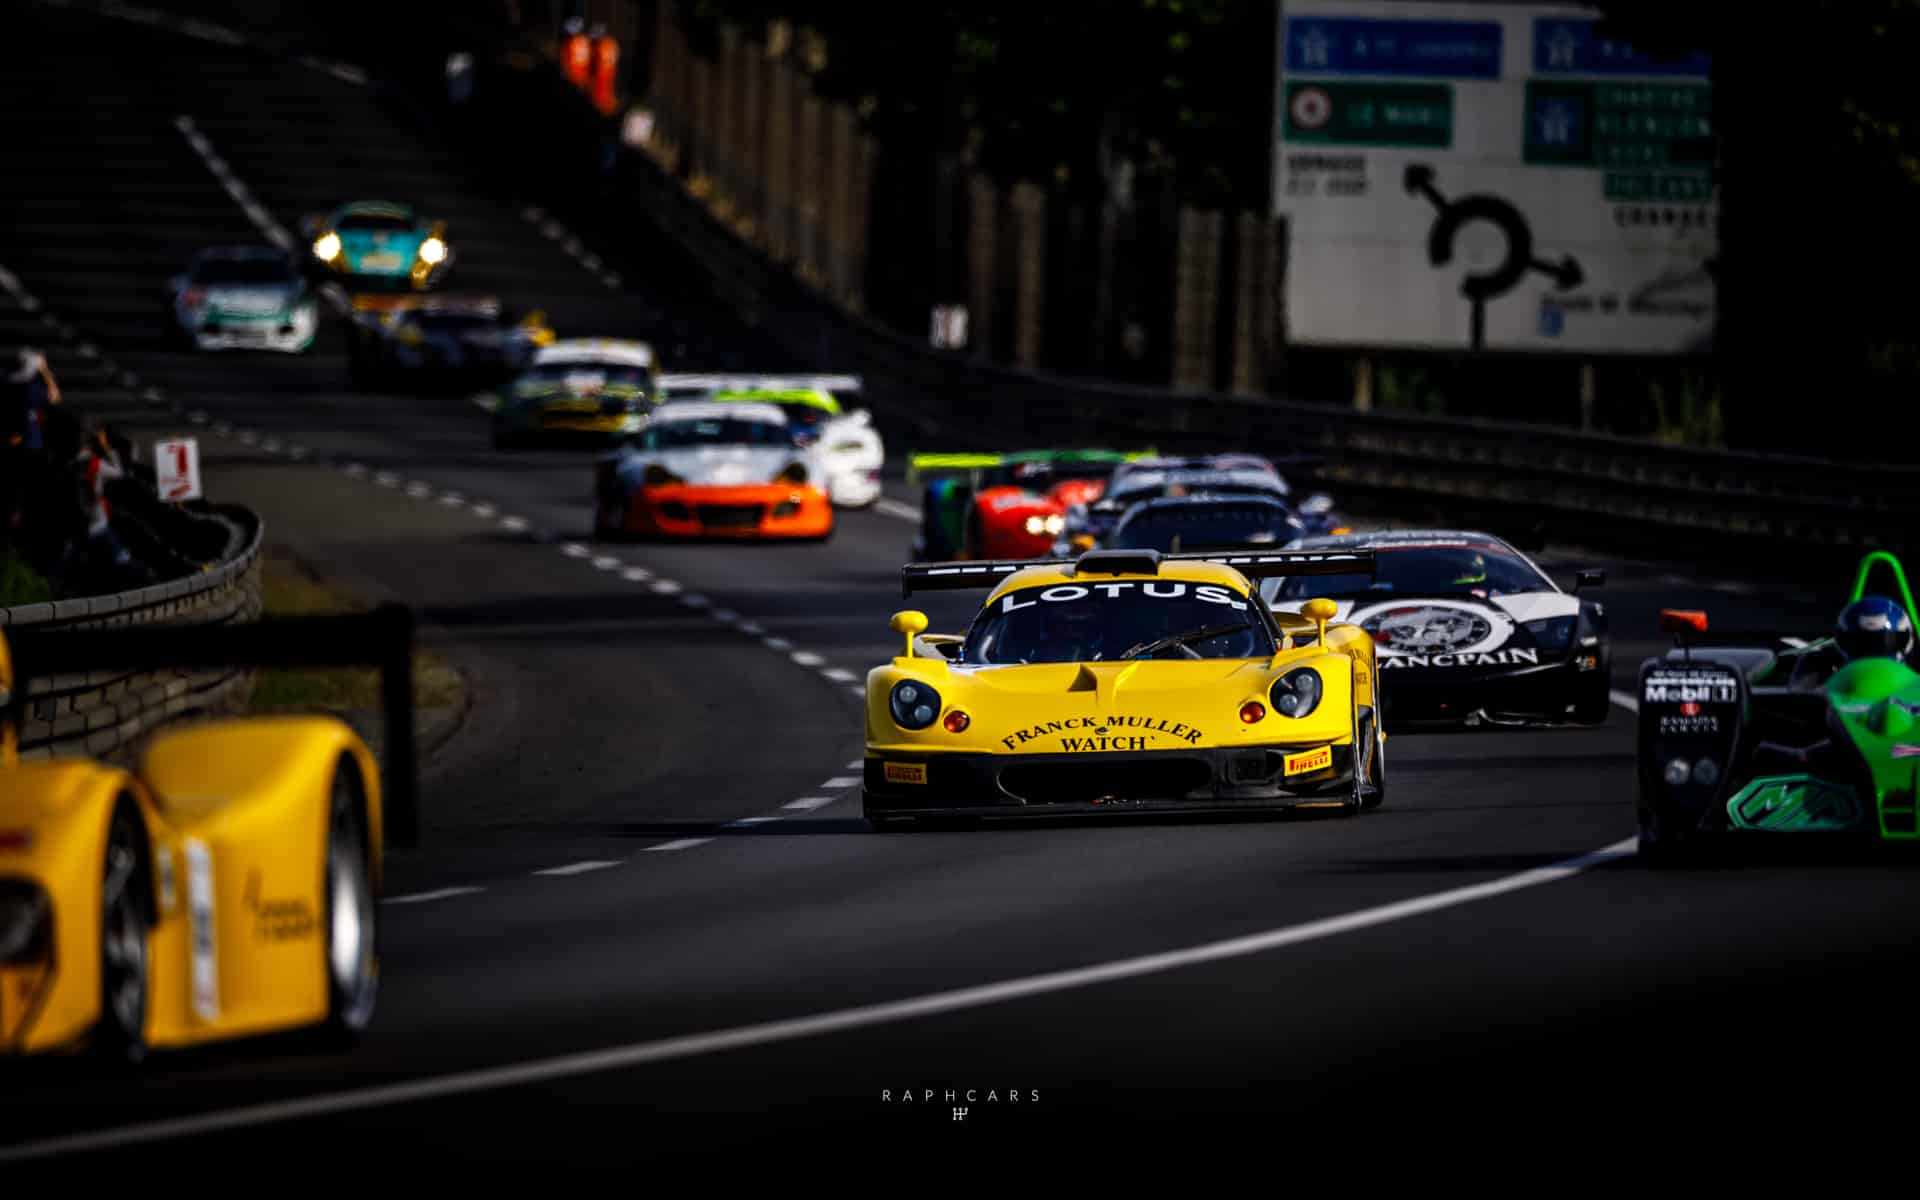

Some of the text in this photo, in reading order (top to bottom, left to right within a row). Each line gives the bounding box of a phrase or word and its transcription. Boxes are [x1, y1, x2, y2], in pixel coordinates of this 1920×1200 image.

[1002, 581, 1235, 613] LOTUS
[1378, 648, 1539, 669] ANCPAIN
[1645, 685, 1711, 703] Mobil
[1002, 716, 1203, 750] FRANCK MULLER
